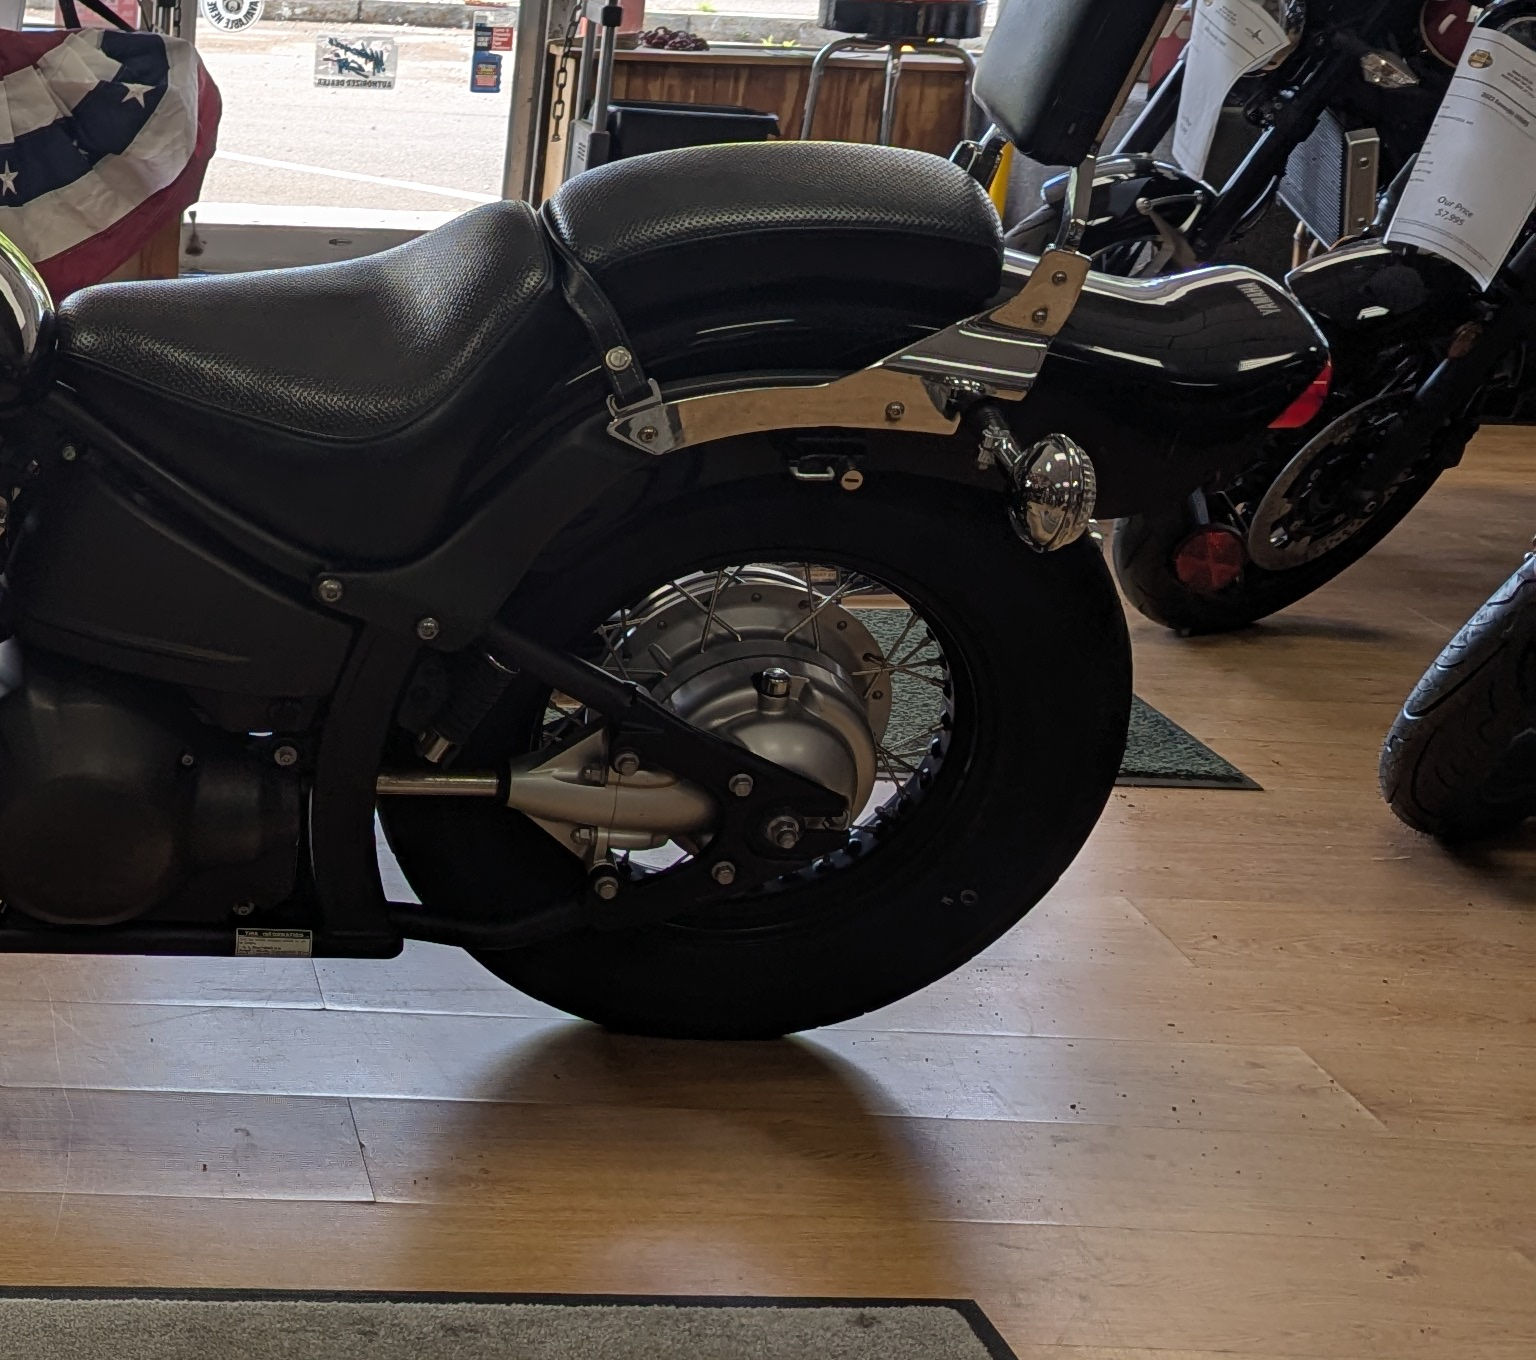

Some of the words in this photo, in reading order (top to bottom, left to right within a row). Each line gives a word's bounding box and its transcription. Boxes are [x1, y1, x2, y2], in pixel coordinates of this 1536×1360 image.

[1433, 208, 1465, 227] $7,995
[1436, 194, 1456, 209] Our
[1454, 199, 1474, 219] Price
[1236, 282, 1282, 318] YAMAHA
